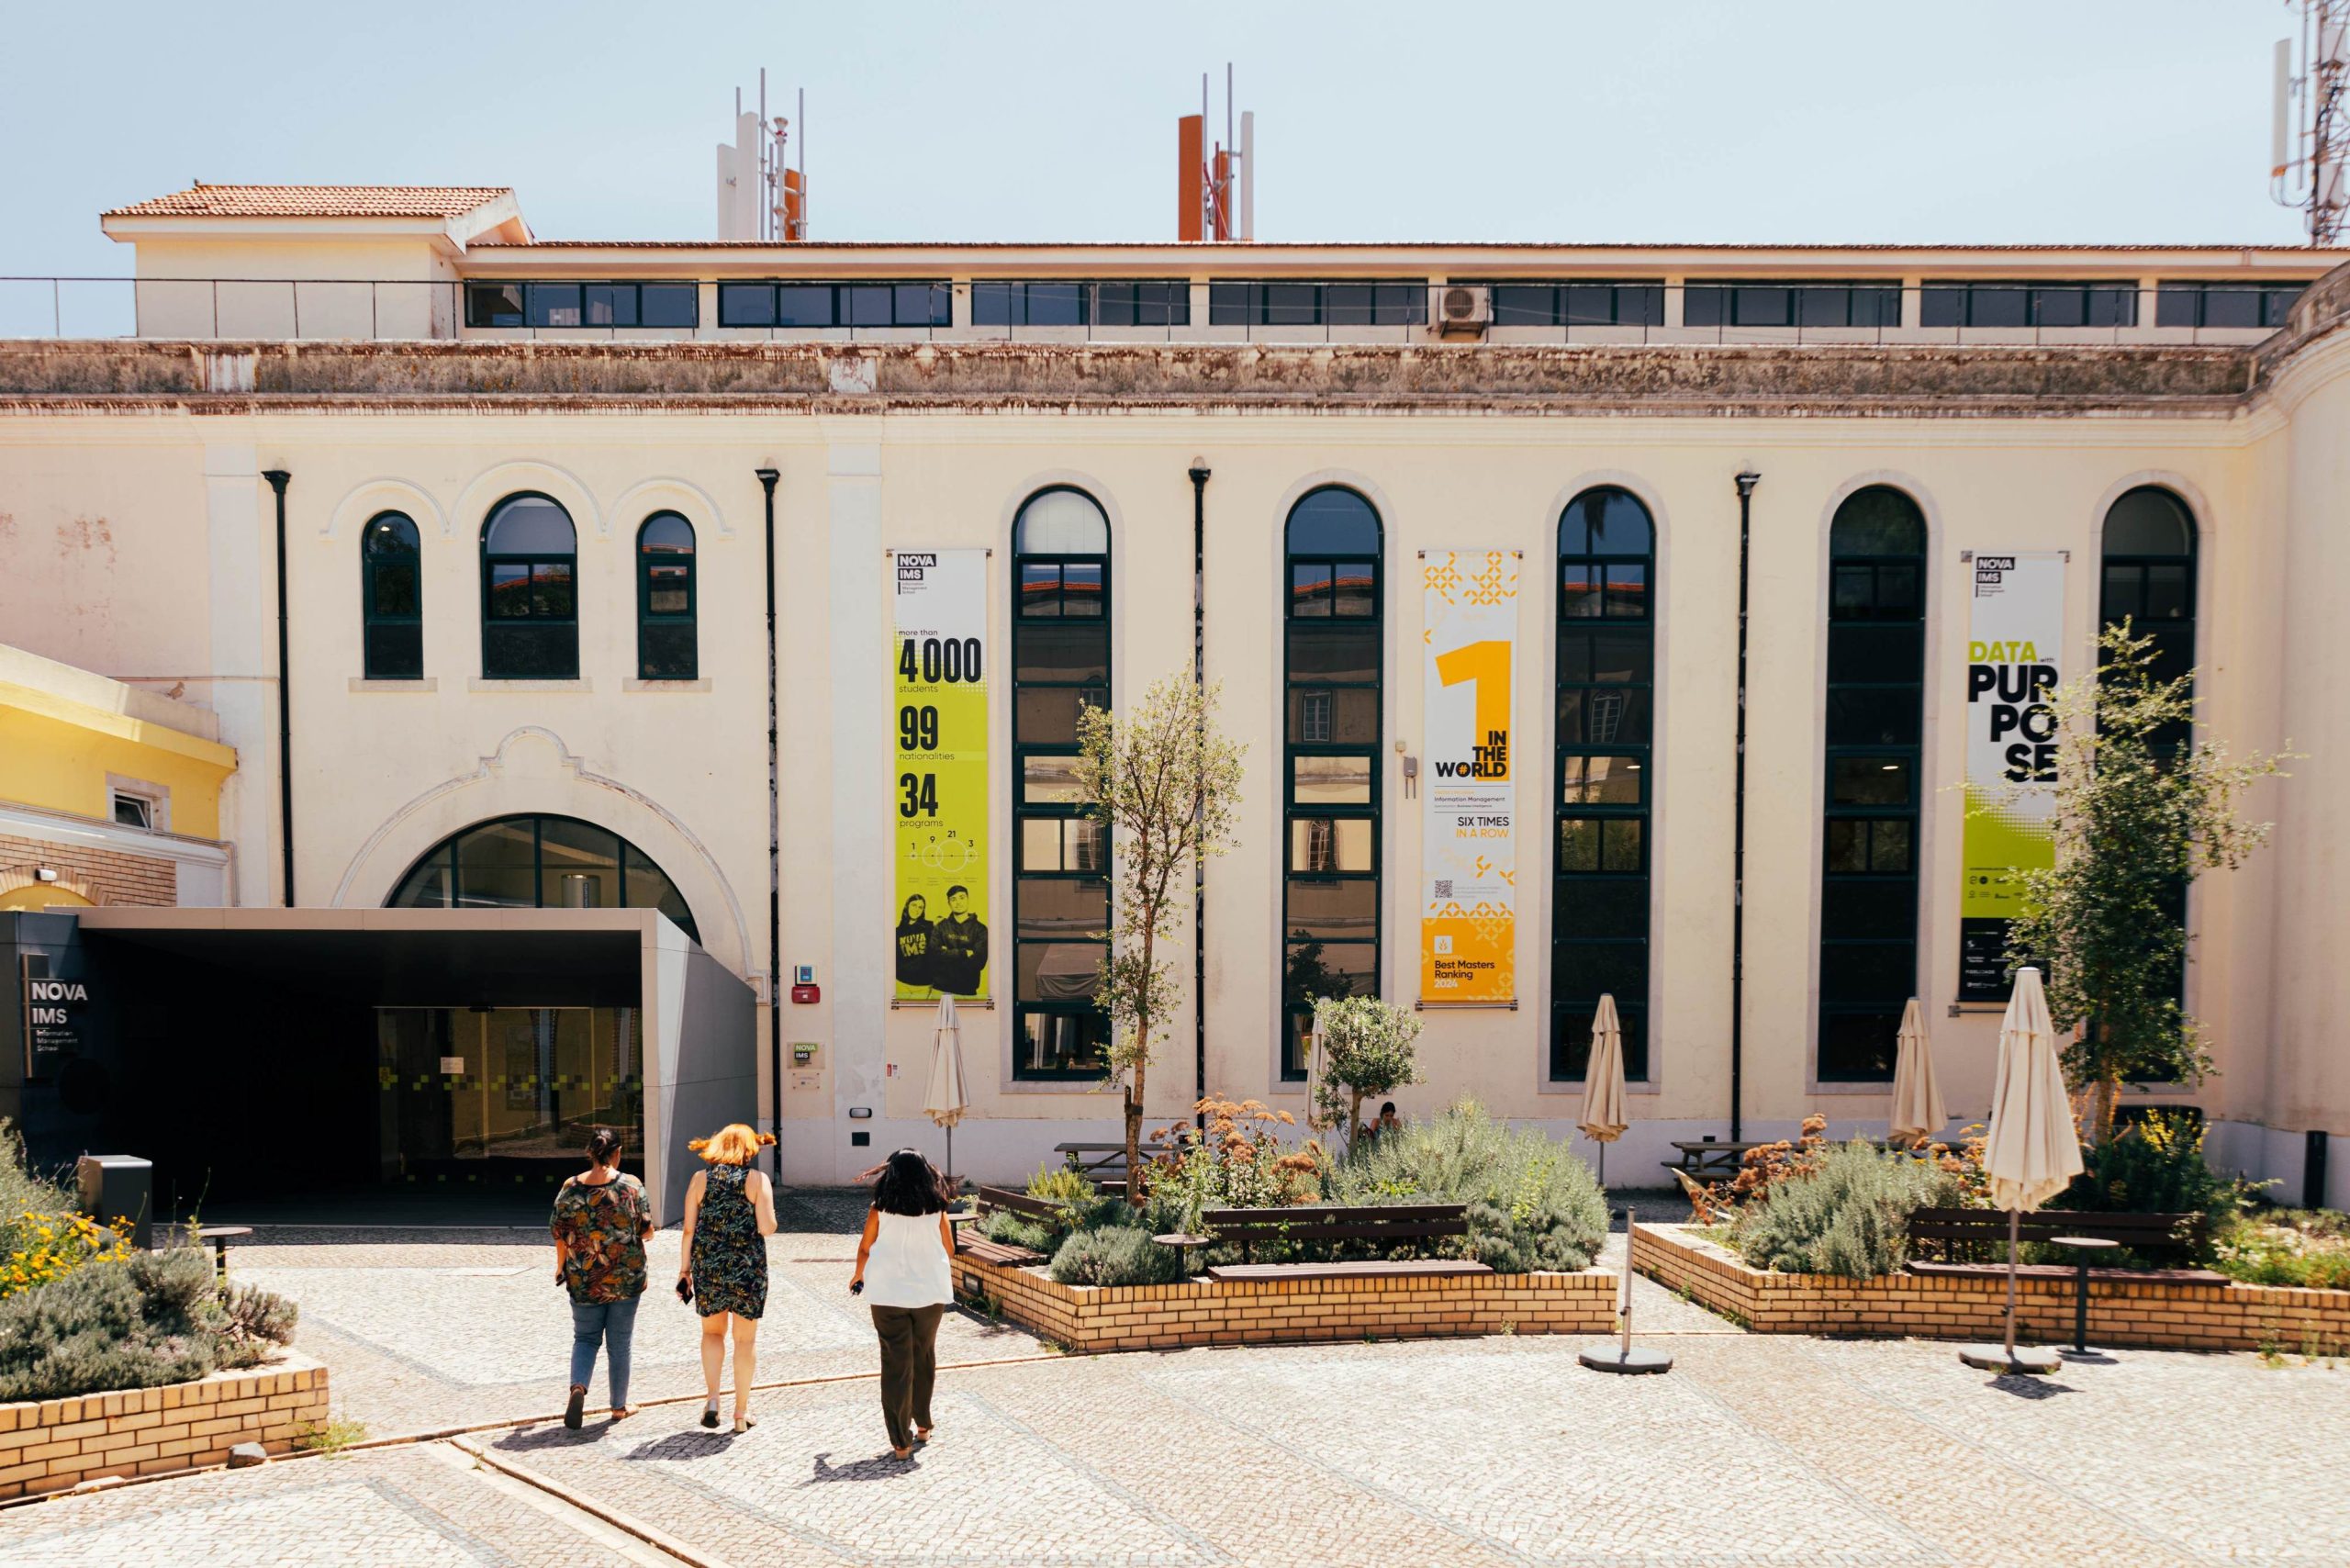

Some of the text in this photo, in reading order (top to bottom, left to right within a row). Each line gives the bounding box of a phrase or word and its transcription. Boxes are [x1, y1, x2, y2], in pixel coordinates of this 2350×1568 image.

[900, 555, 934, 566] NOVA
[1978, 559, 2013, 569] NOVA
[900, 569, 922, 579] IMS
[1977, 573, 1999, 582] IMS
[1969, 641, 2038, 663] DATA
[1968, 665, 2058, 703] PUR
[1435, 641, 1511, 781] 1
[901, 705, 938, 751] 99
[1990, 704, 2058, 743] PO
[1488, 731, 1506, 745] IN
[899, 752, 955, 760] nationalities
[1472, 746, 1506, 761] THE
[2004, 743, 2059, 782] SE
[1435, 762, 1506, 778] WORLD
[901, 773, 938, 818] 34
[900, 820, 944, 829] programs
[1458, 816, 1509, 826] SIX TIMES
[947, 830, 957, 838] 21
[1456, 828, 1509, 837] IN A ROW
[912, 842, 915, 850] 1
[968, 839, 974, 847] 3
[1435, 960, 1495, 969] Best Masters
[1435, 969, 1473, 980] Ranking
[1434, 979, 1458, 988] 2024
[32, 982, 88, 1001] NOVA
[32, 1007, 67, 1025] IMS
